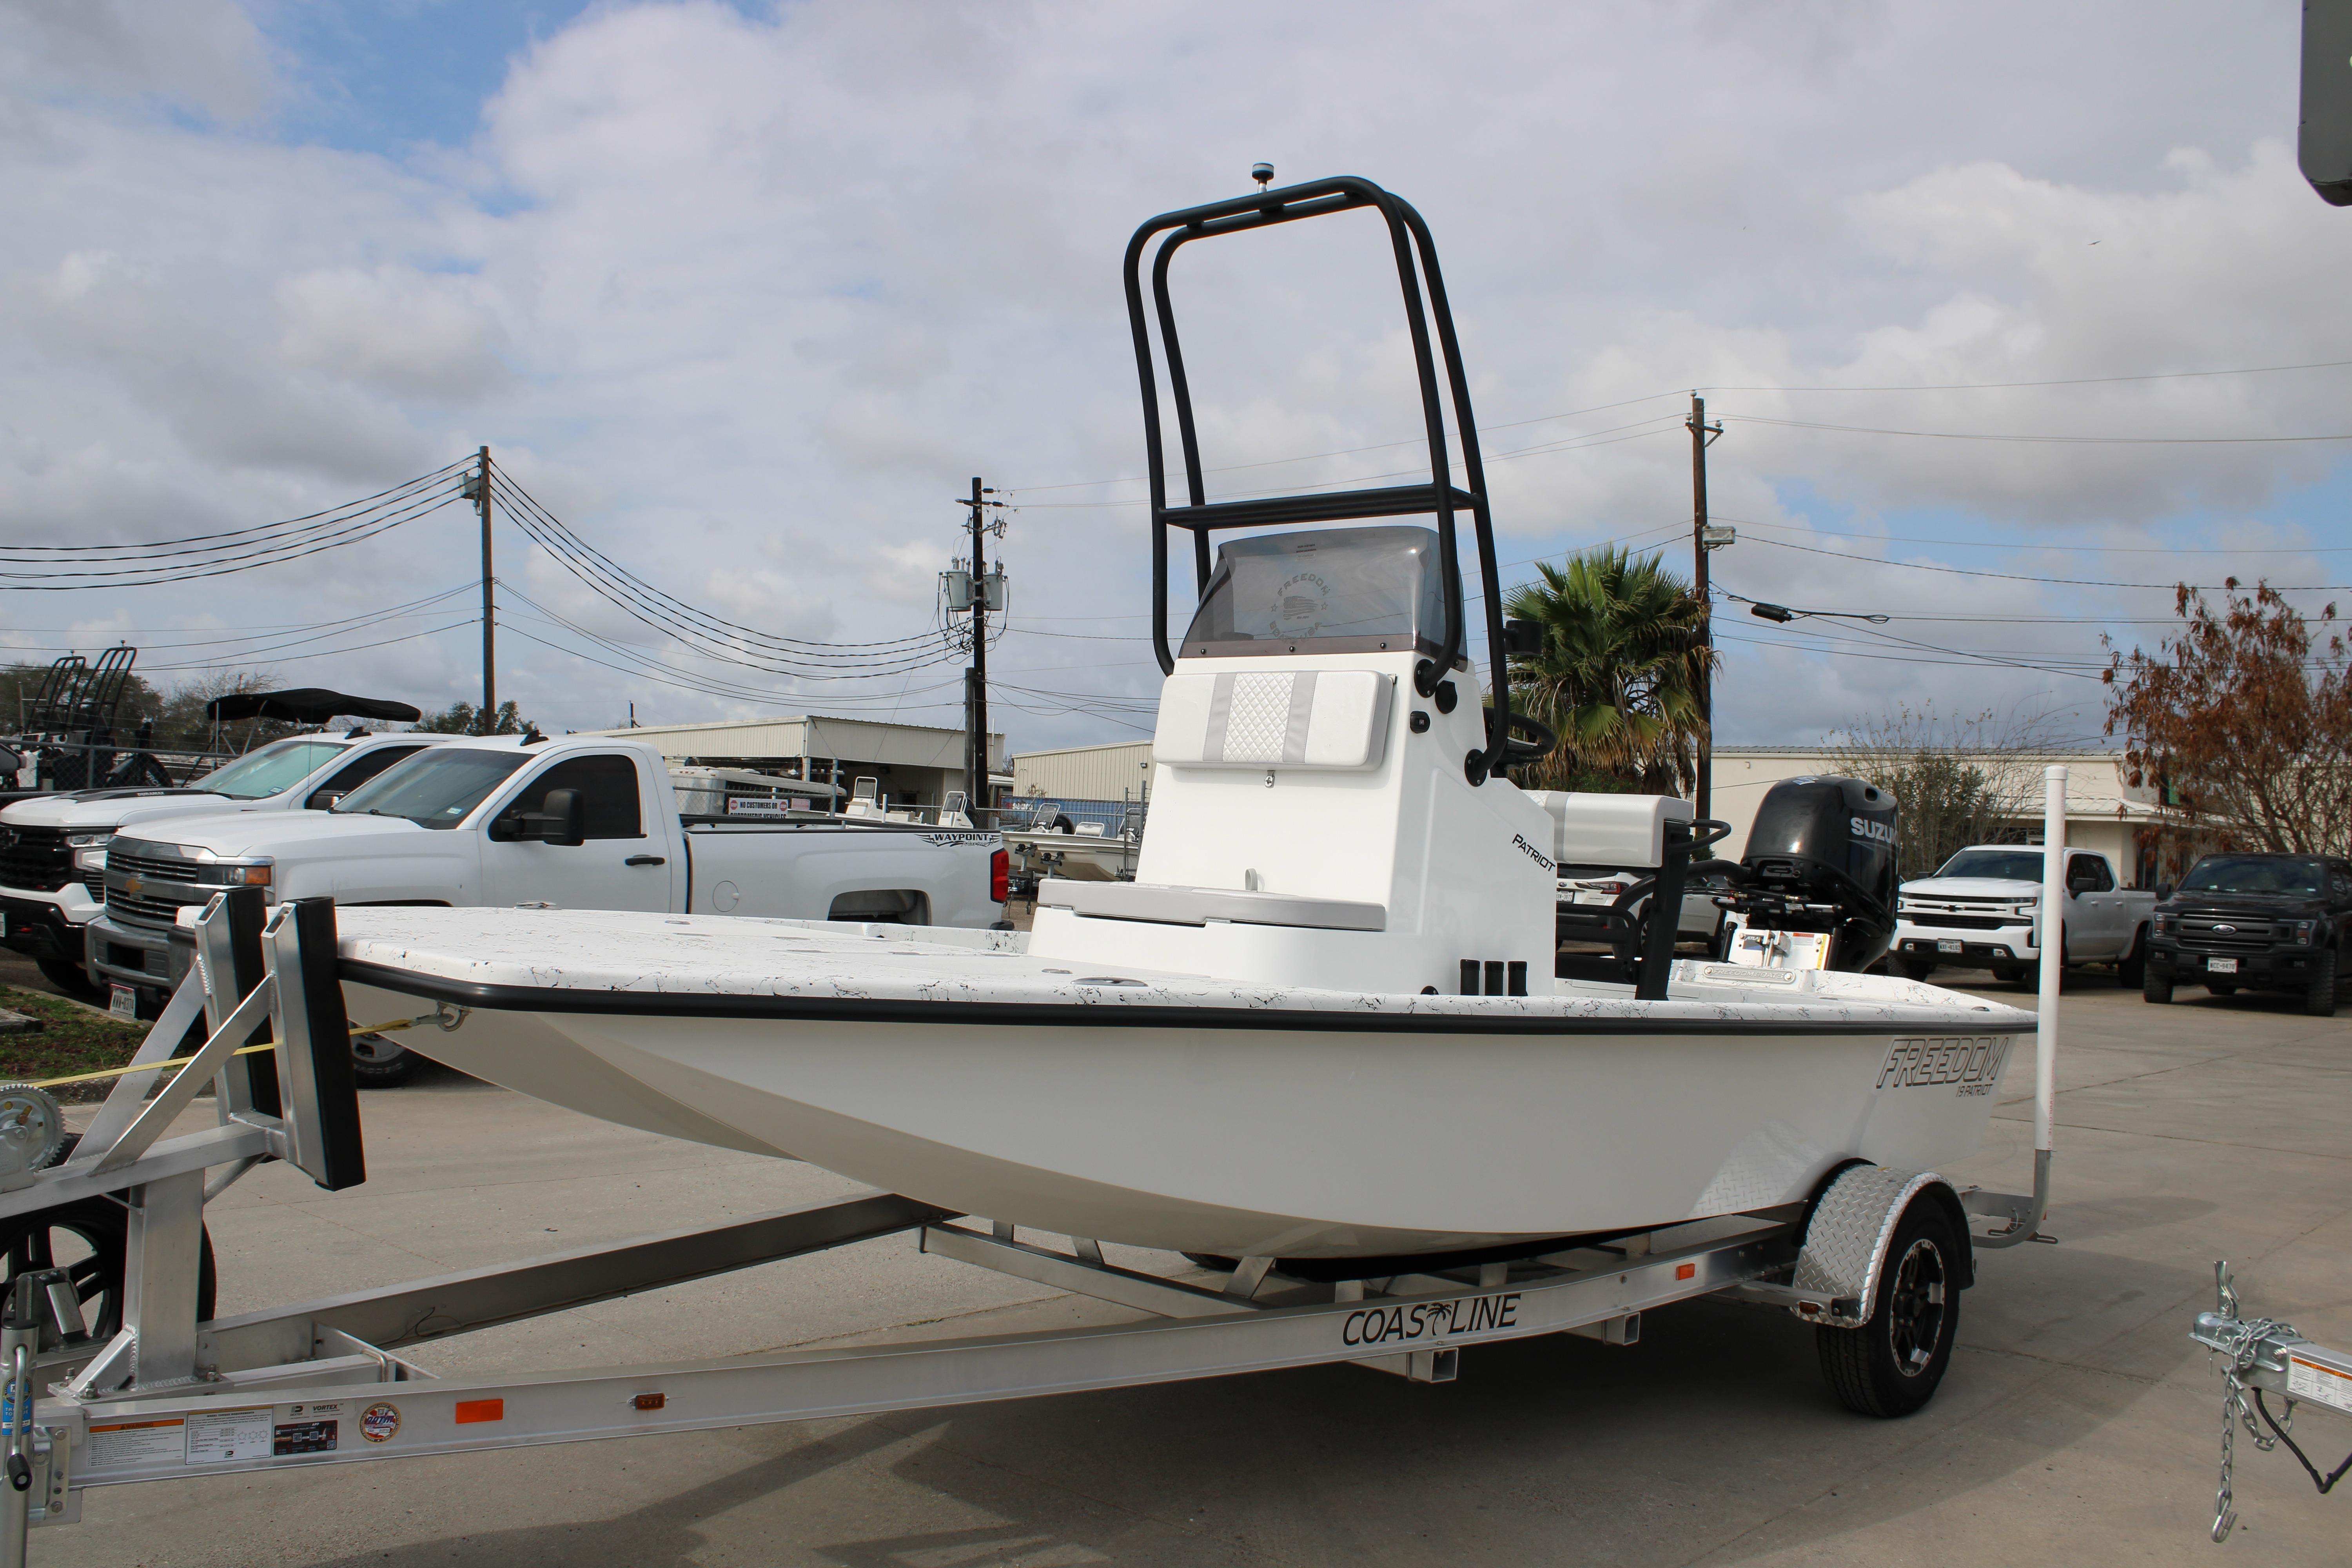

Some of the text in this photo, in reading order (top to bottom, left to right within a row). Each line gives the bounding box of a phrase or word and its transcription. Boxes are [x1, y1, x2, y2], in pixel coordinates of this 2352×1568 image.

[1278, 573, 1329, 597] FREEDOM
[1851, 817, 1899, 847] SUZUK
[1512, 833, 1555, 871] PATRIOT
[1876, 1037, 2009, 1089] FREEDOM
[1956, 1083, 1993, 1097] 19 PATRIOT
[1343, 1293, 1521, 1346] COASLINE
